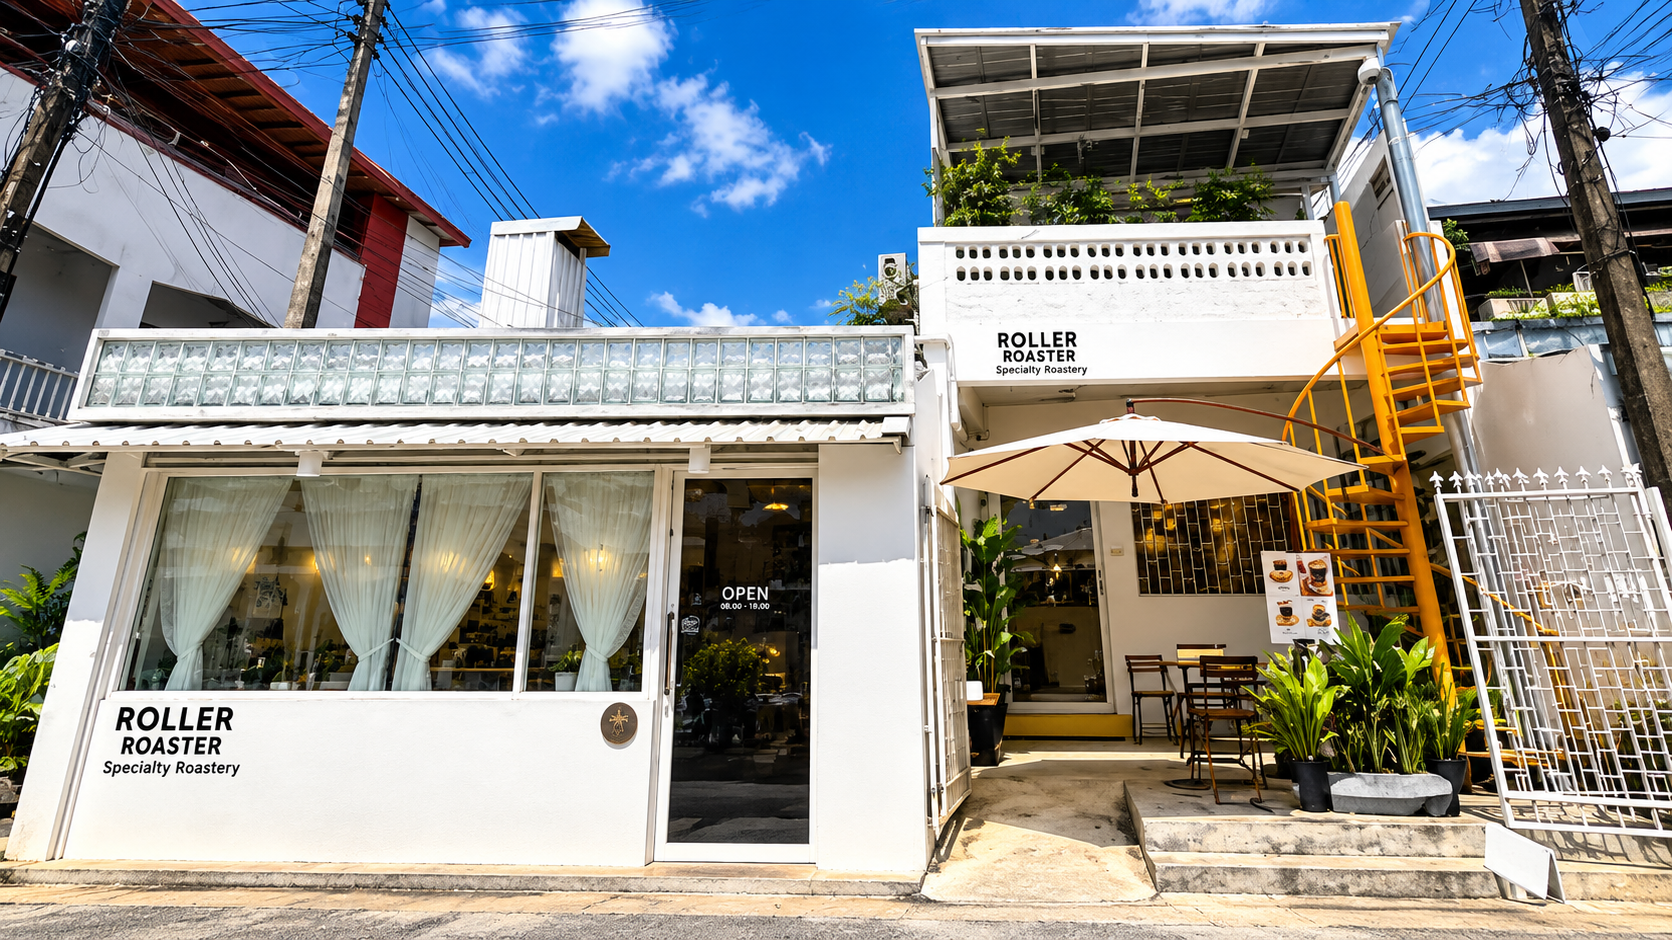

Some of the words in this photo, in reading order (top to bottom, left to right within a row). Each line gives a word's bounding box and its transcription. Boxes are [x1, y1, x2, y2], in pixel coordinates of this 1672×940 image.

[997, 331, 1077, 348] ROLLER
[1003, 349, 1076, 363] ROASTER
[996, 364, 1041, 377] Specialty
[1044, 364, 1088, 377] Roastery
[722, 586, 769, 601] OPEN
[115, 706, 234, 732] ROLLER
[120, 736, 222, 755] ROASTER
[102, 760, 171, 777] Specialty
[175, 761, 241, 777] Roastery
